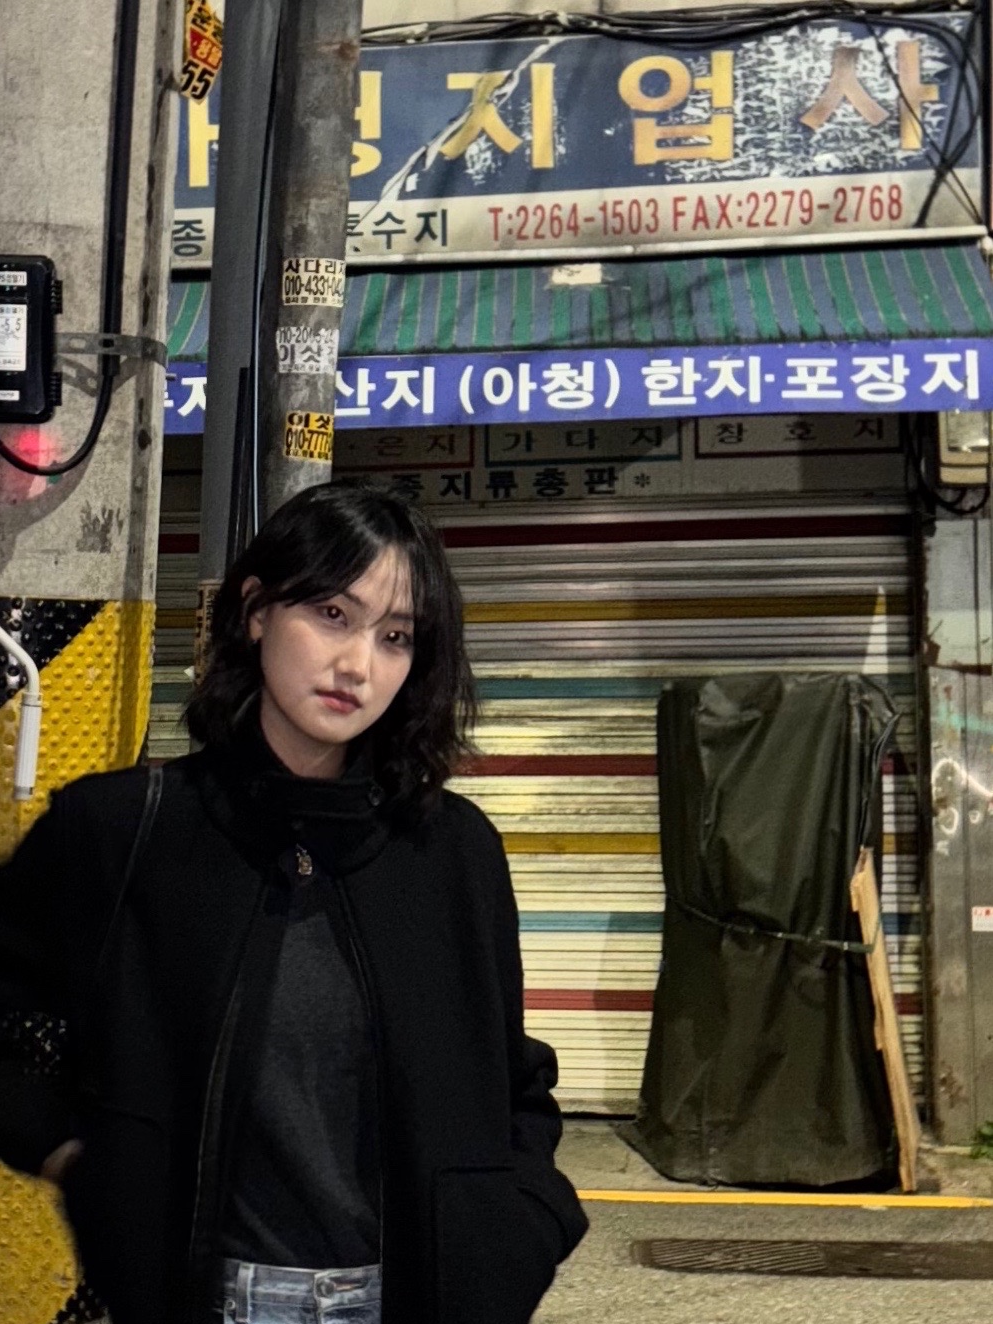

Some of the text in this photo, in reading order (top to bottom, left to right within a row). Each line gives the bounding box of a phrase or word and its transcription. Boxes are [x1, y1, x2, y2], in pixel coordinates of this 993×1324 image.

[487, 198, 660, 242] T:2264-1503
[672, 184, 904, 232] FAX:2279-2768
[459, 358, 620, 414] (아청)
